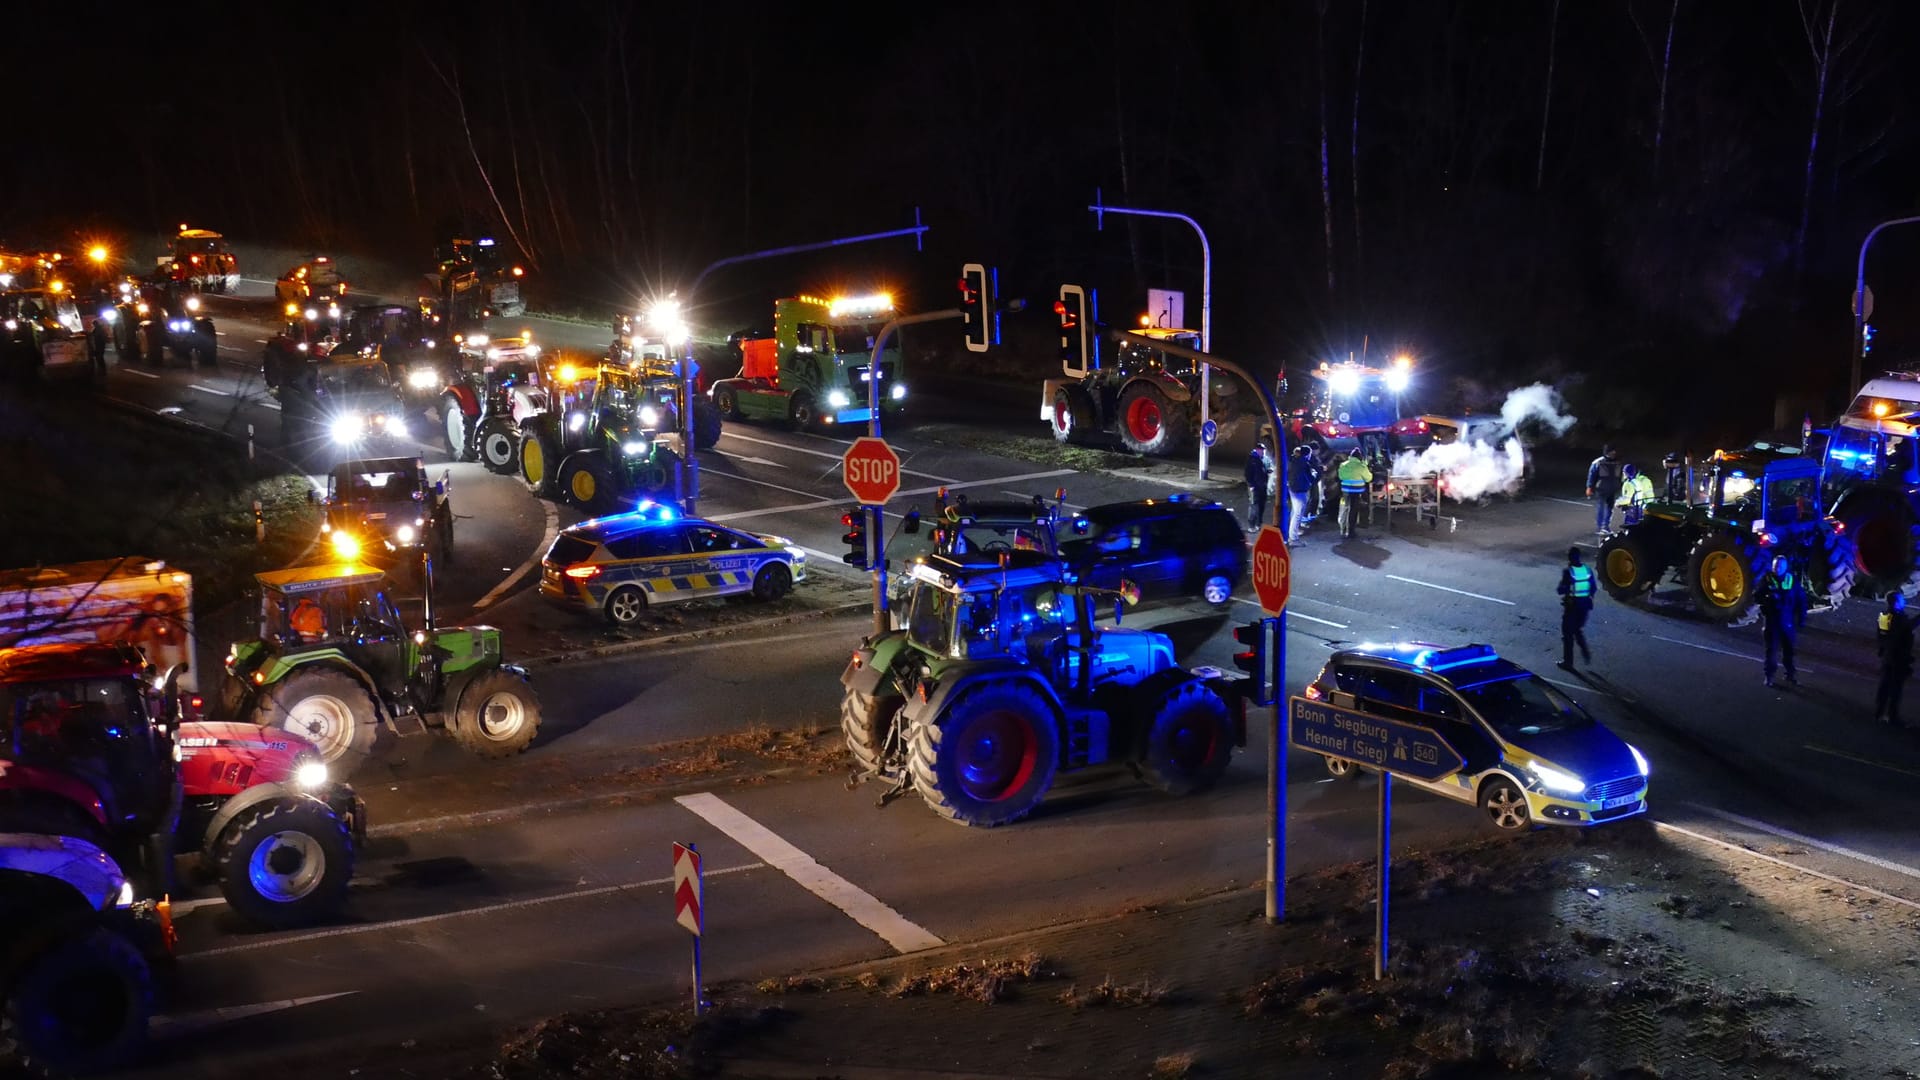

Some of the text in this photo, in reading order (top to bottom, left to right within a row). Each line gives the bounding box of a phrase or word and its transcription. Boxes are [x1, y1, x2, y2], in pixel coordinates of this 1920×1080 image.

[849, 457, 894, 484] STOP
[709, 559, 741, 570] POLIZEI
[1256, 551, 1287, 590] STOP
[1296, 704, 1388, 743] Bonn Siegburg
[1305, 727, 1434, 764] Hennef (Sieg) 560
